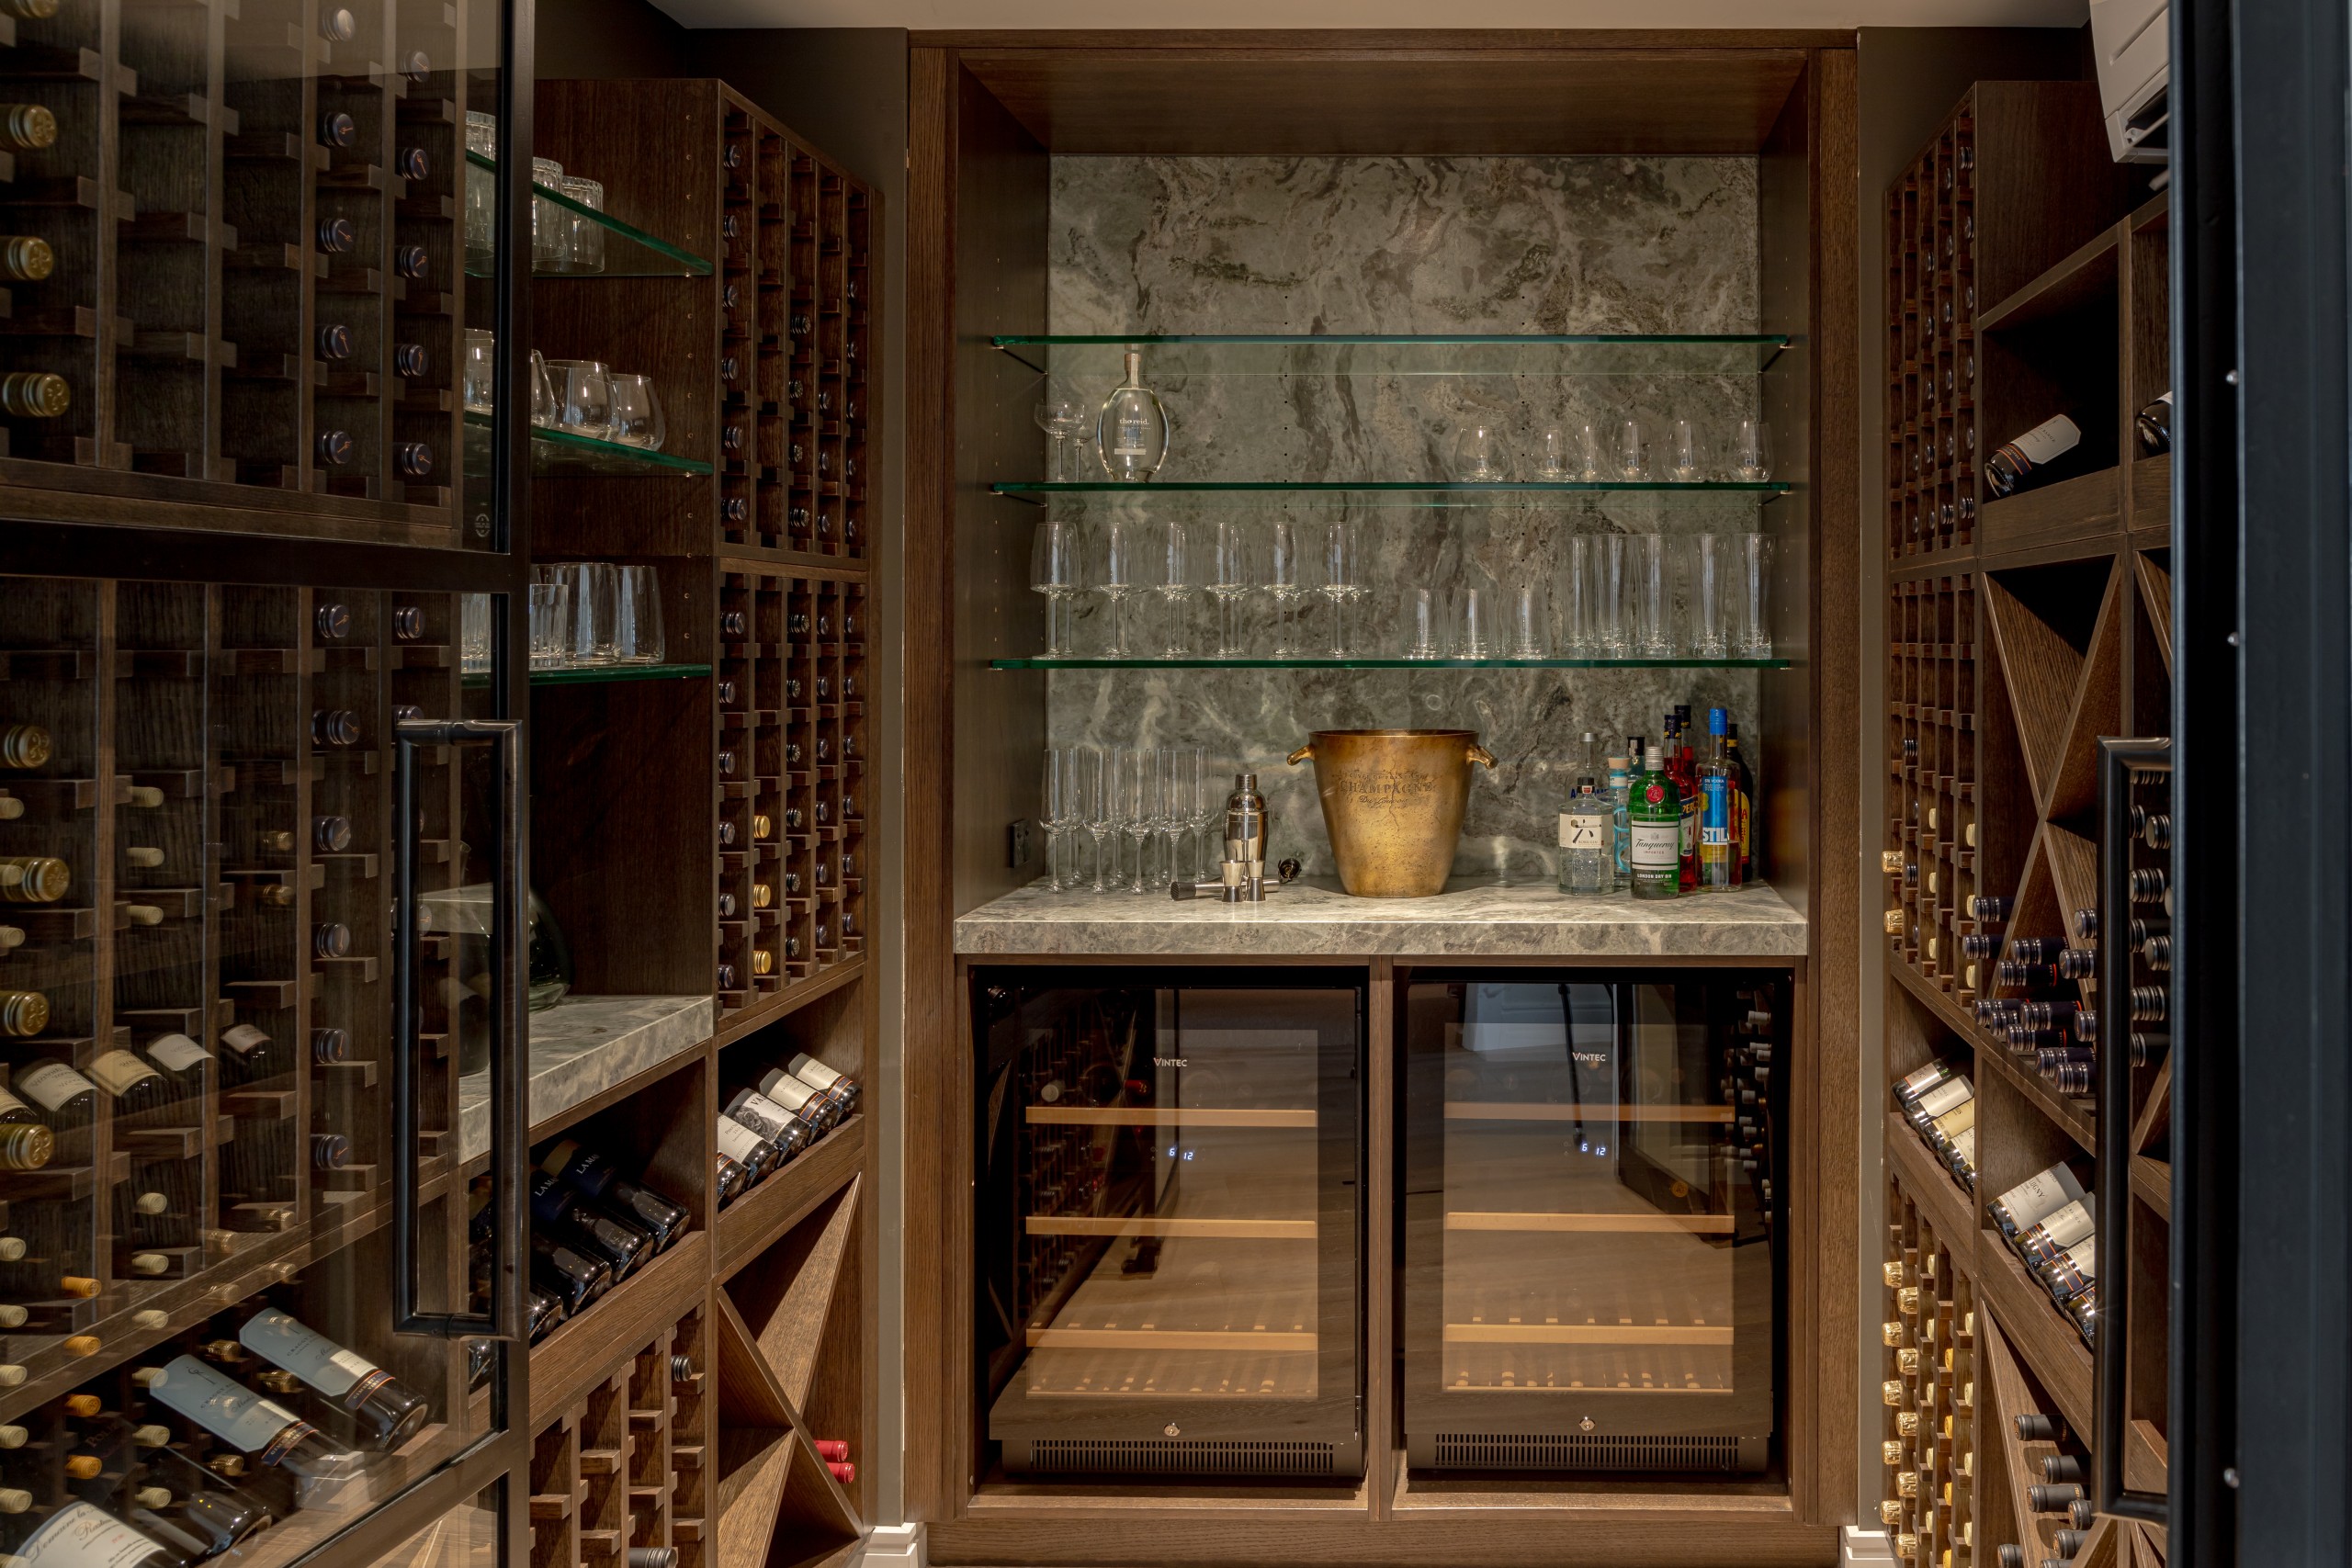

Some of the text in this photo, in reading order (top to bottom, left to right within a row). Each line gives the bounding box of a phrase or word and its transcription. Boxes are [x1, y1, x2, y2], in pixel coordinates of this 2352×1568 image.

[1340, 780, 1432, 794] CHAMPAGNE
[1702, 828, 1727, 842] STIL
[1635, 838, 1675, 851] Tanqueray
[1153, 1057, 1188, 1066] VINTEC
[1572, 1052, 1606, 1062] VINTEC
[1183, 1152, 1193, 1160] 12
[1596, 1147, 1606, 1156] 12
